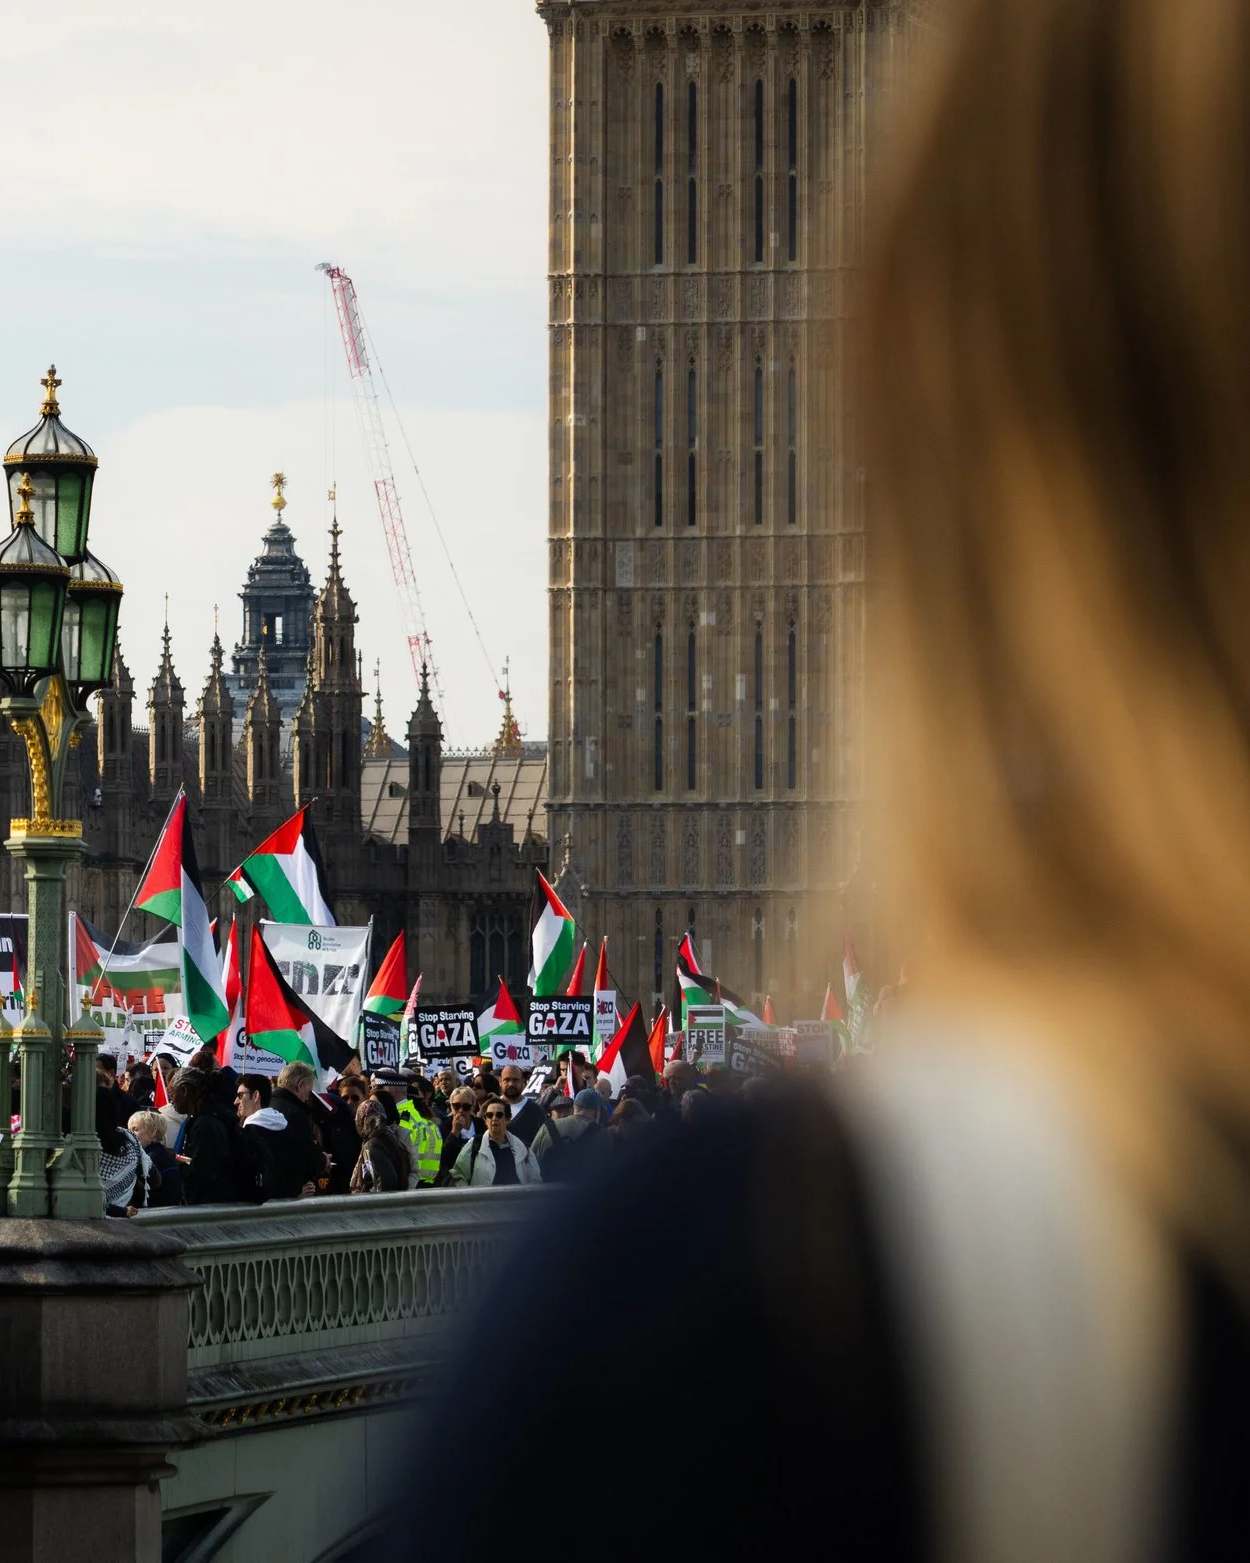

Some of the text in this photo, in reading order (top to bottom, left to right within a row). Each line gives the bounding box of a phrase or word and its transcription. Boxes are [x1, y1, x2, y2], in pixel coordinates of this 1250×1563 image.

[91, 977, 166, 1015] FREE
[529, 1001, 591, 1013] Stop Starving
[418, 1010, 475, 1023] Stop Starving
[528, 1012, 590, 1036] GAZA
[174, 1019, 197, 1035] ST
[366, 1028, 380, 1040] Stop
[797, 1023, 829, 1035] STOP
[168, 1029, 202, 1047] ARMING
[420, 1022, 477, 1049] GAZA
[688, 1029, 724, 1044] FREE
[367, 1040, 396, 1067] GAZA
[493, 1041, 530, 1061] Gza
[688, 1043, 724, 1051] PASTINE
[256, 1056, 284, 1065] genocide
